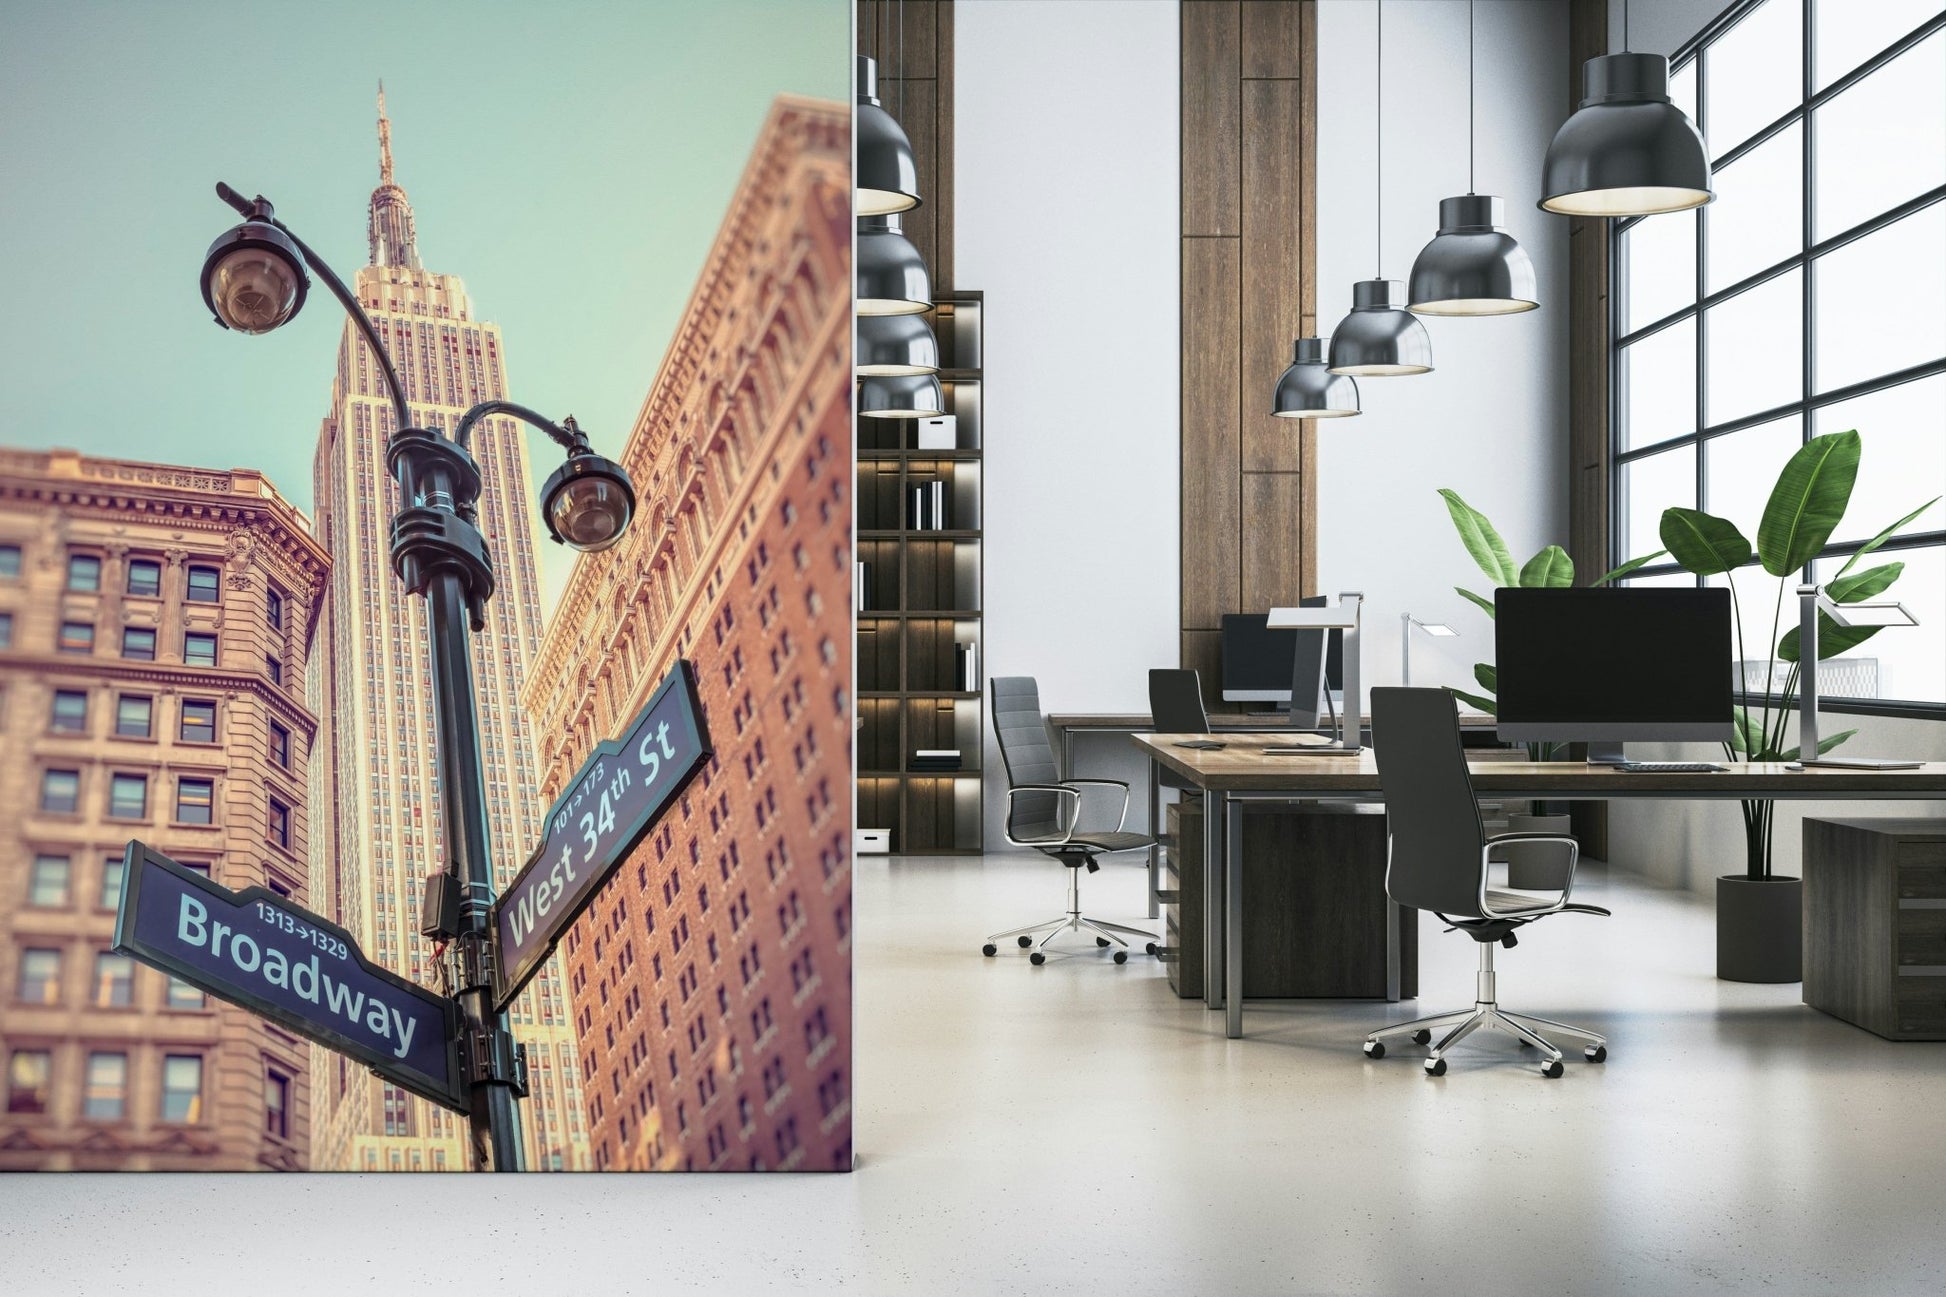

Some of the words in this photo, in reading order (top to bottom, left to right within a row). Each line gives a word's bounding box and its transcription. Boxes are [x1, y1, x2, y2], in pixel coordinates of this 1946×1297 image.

[508, 843, 577, 948] West
[579, 767, 631, 864] 34th
[639, 719, 675, 786] St
[177, 892, 417, 1059] Broadway
